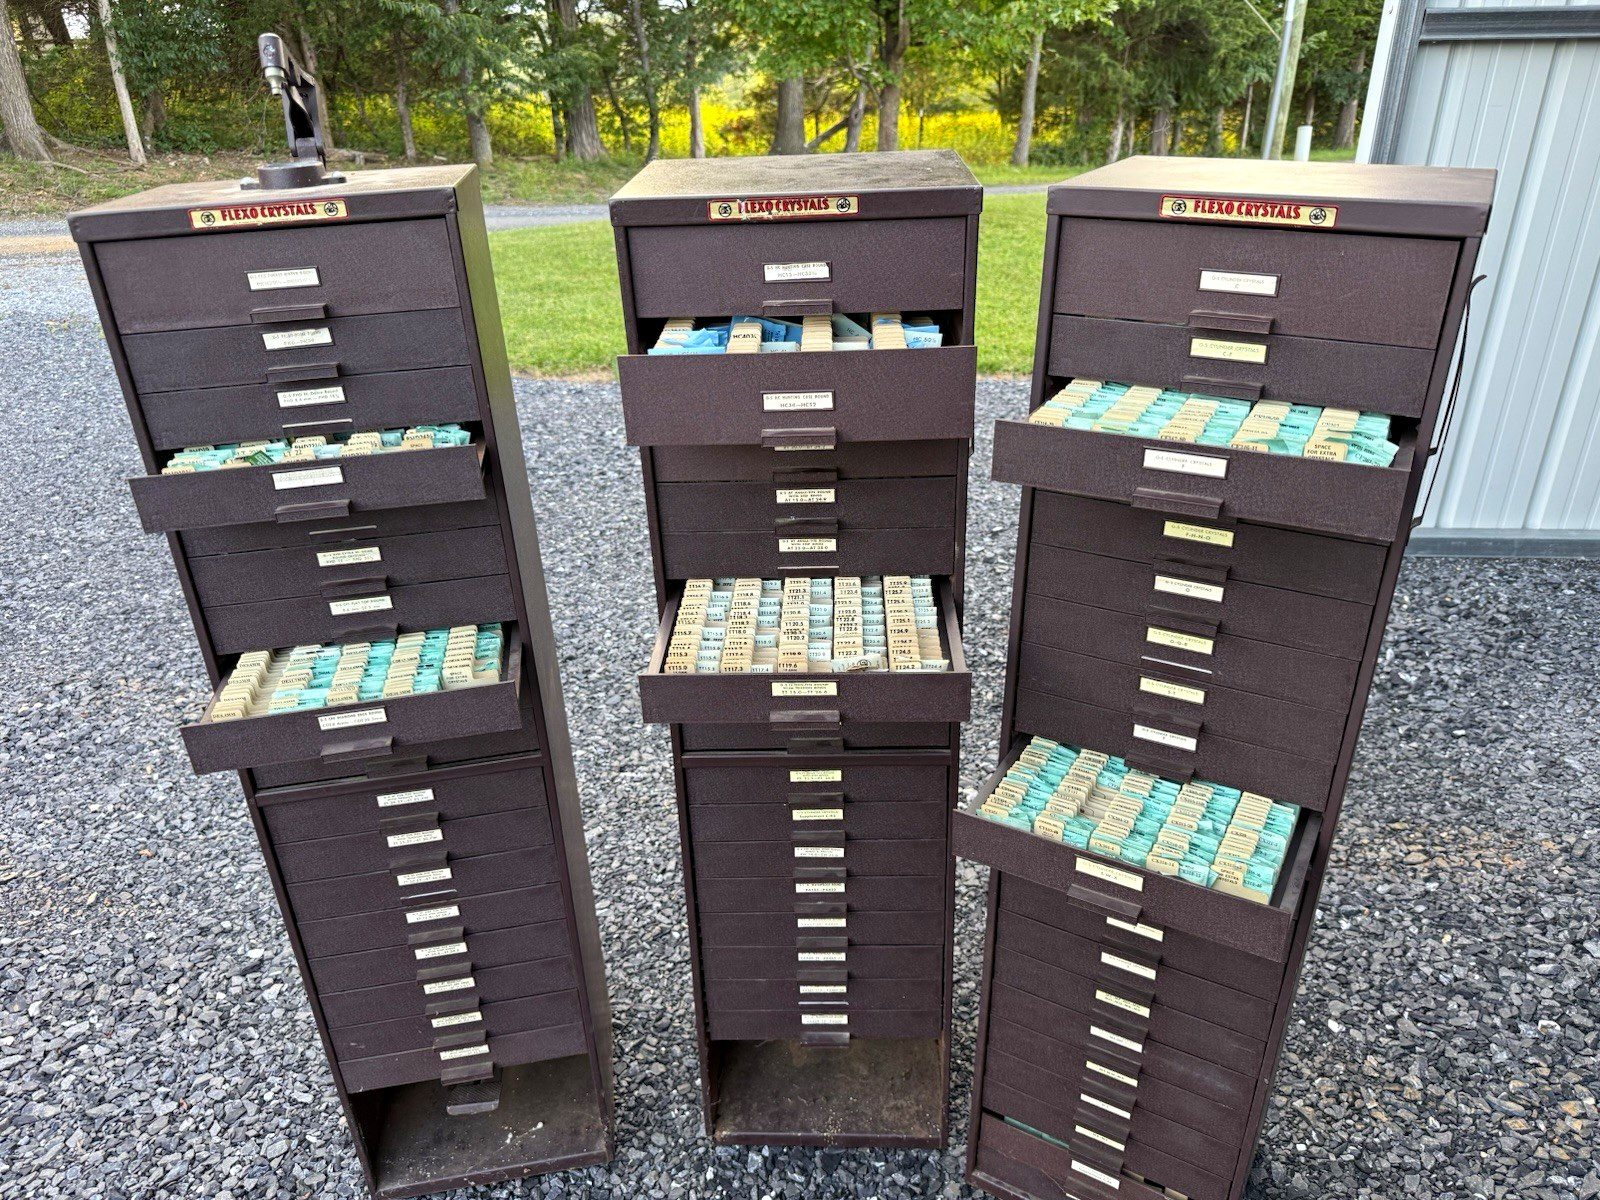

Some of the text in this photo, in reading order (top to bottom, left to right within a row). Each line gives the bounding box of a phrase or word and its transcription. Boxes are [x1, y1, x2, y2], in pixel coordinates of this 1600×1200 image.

[220, 203, 318, 221] FLEXO CRYSTALS
[775, 198, 830, 212] CRYSTALS
[1193, 200, 1235, 215] FLEXO
[1237, 202, 1301, 220] CRYSTALS
